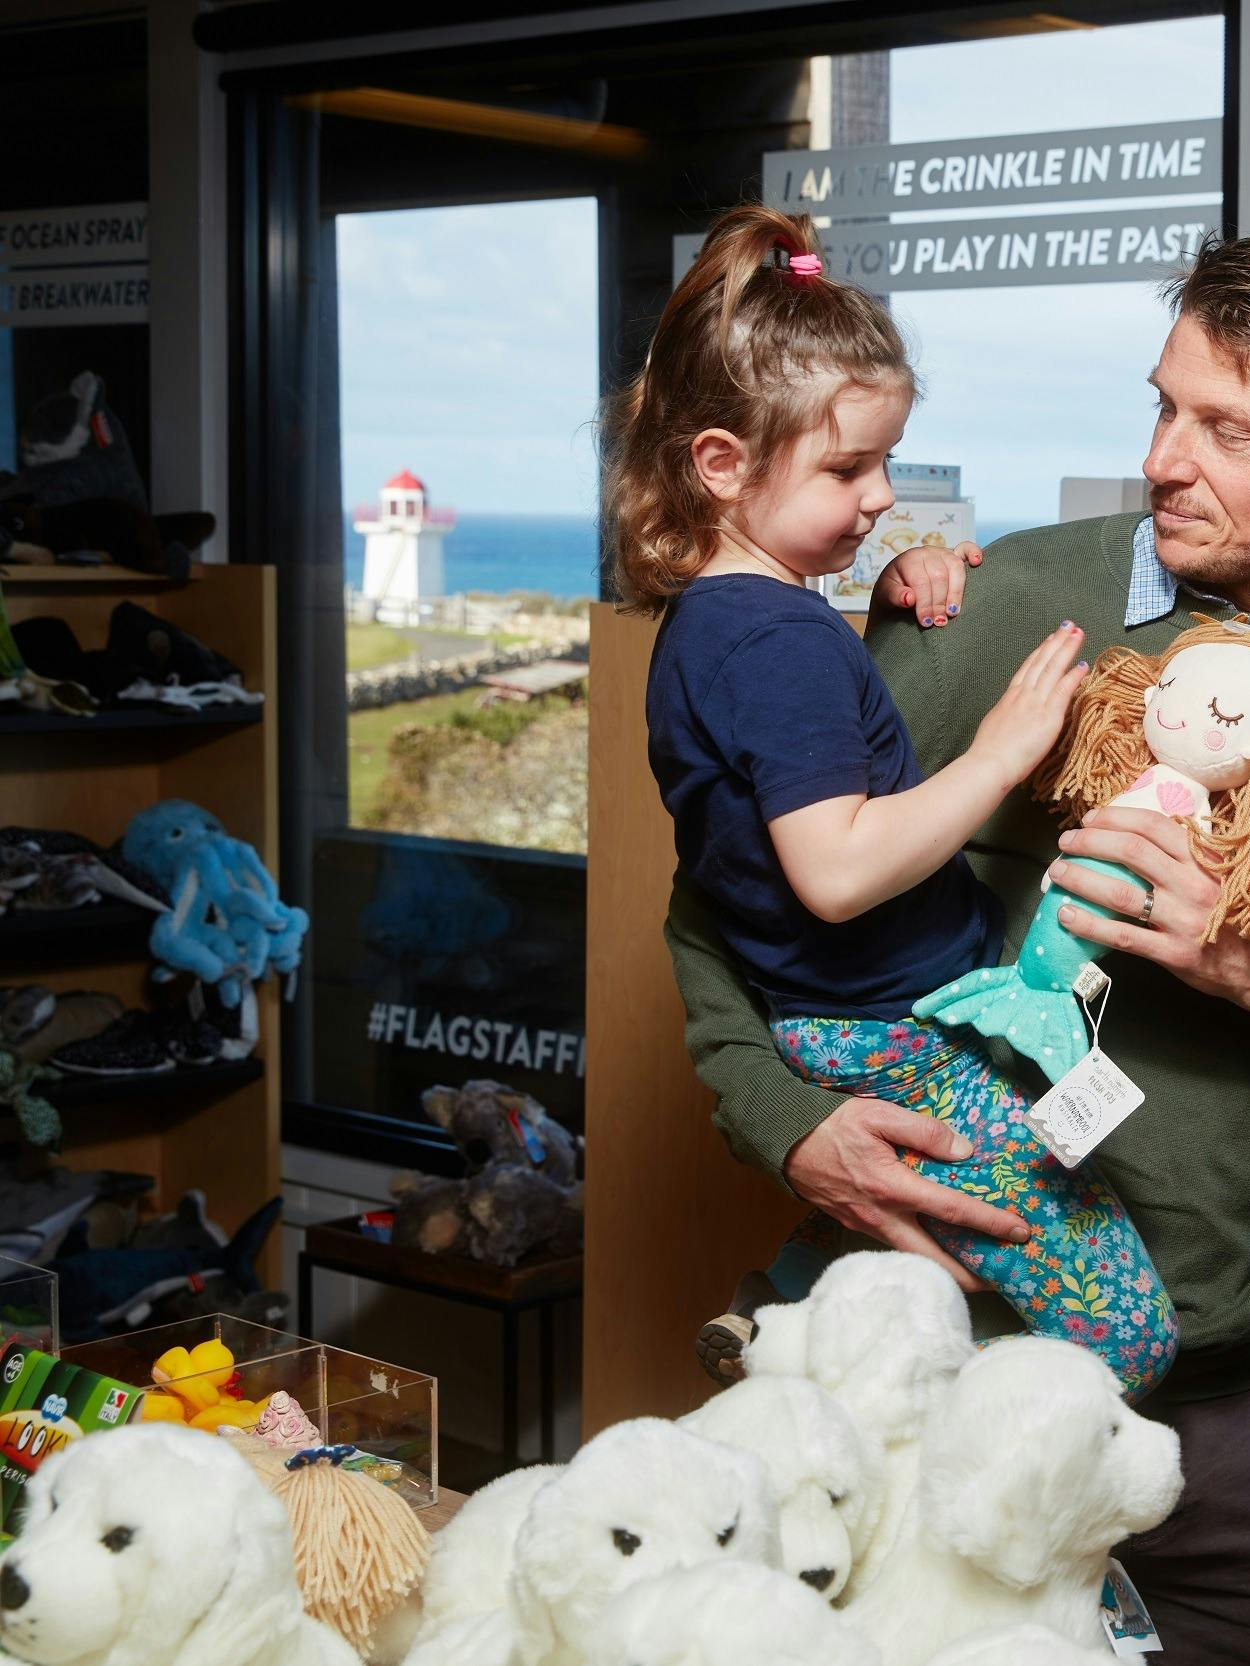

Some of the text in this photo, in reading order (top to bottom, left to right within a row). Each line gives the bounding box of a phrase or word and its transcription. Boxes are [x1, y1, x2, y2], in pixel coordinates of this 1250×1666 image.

[920, 148, 1065, 194] CRINKLE
[1070, 145, 1111, 184] IN
[1118, 137, 1206, 180] TIME
[11, 222, 81, 250] OCEAN
[84, 217, 146, 246] SPRAY
[842, 238, 907, 275] YOU
[913, 235, 995, 275] PLAY
[997, 232, 1036, 270] IN
[1042, 228, 1117, 267] THE
[1120, 222, 1207, 263] PAST
[18, 279, 149, 310] BREAKWATER
